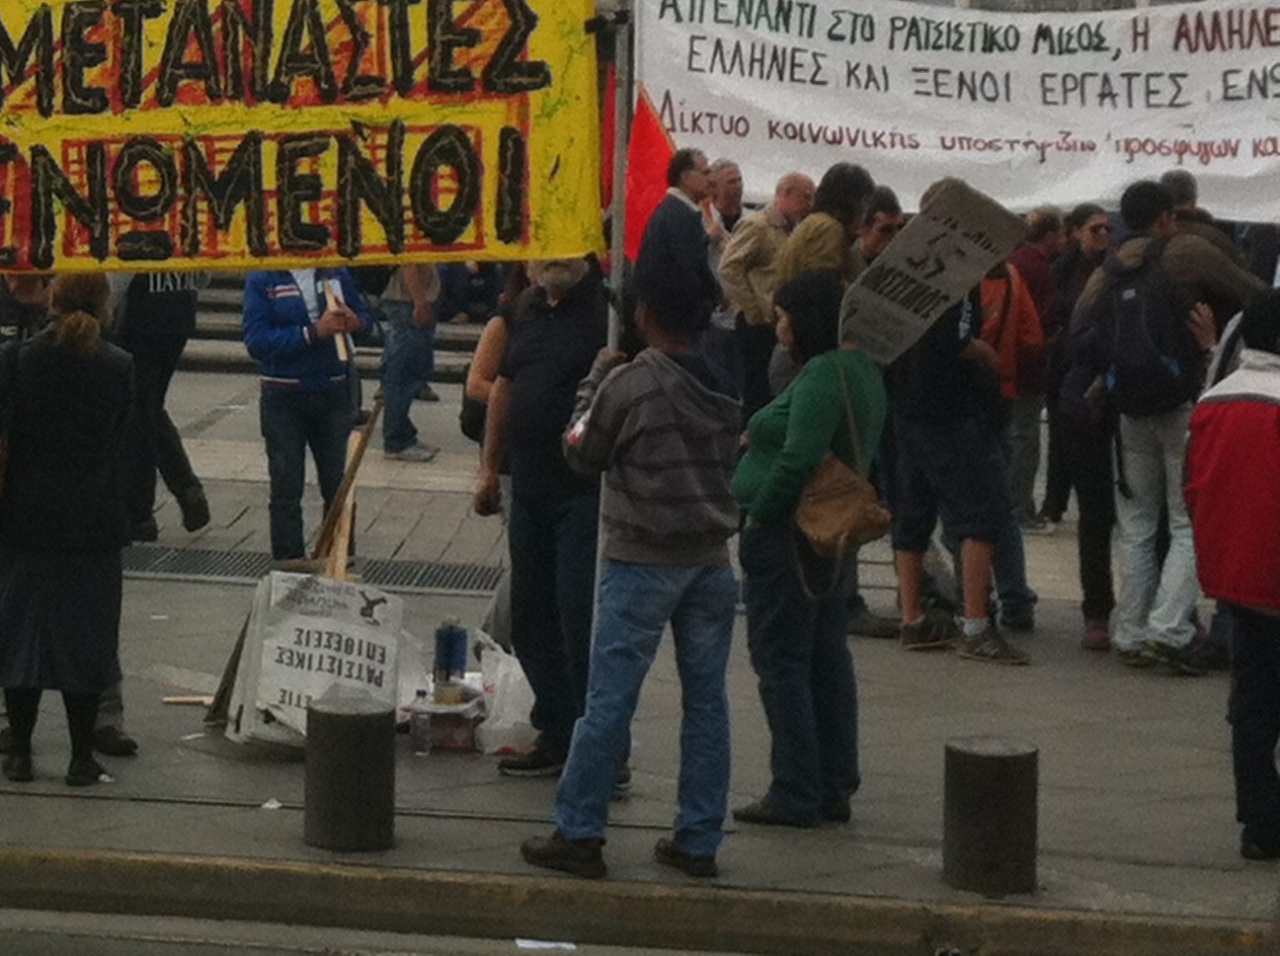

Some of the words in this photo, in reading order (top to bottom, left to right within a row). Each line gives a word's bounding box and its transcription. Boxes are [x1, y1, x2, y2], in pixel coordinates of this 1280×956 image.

[826, 8, 876, 45] ΣΤΟ
[888, 15, 1021, 54] ΡΑΤΣΙΣΤΙΚΟ
[1131, 15, 1150, 52] Η
[686, 34, 829, 87] ΕΛΛΗΝΕΣ
[845, 59, 891, 93] ΚΑΙ
[911, 66, 1012, 103] ΞΕΝΟΙ
[274, 645, 385, 688] ΡΑΤΣΙΣΤΙΚΕΣ
[293, 627, 387, 665] ΕΠΙΘΕΣΕΙΣ
